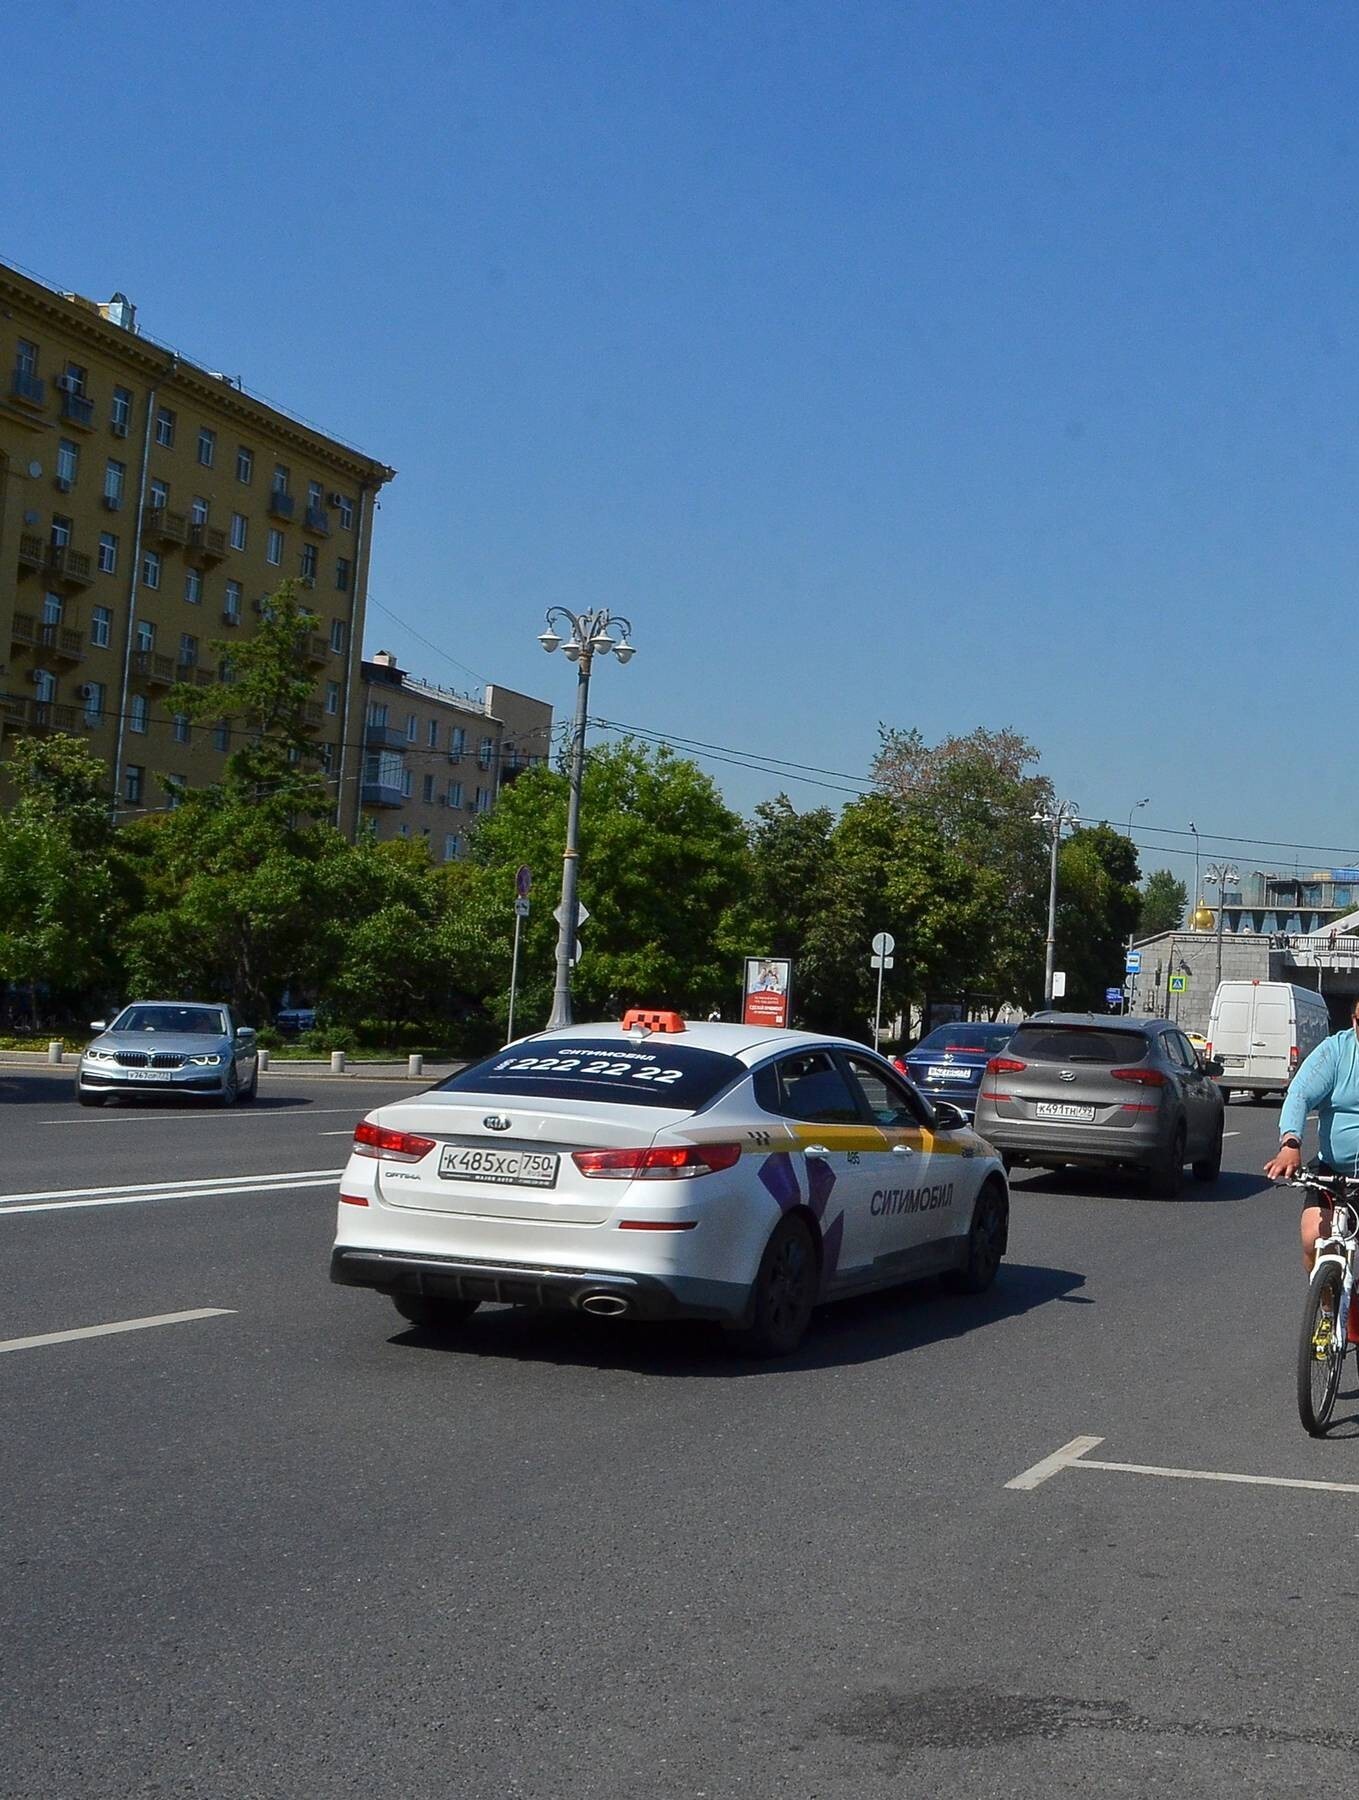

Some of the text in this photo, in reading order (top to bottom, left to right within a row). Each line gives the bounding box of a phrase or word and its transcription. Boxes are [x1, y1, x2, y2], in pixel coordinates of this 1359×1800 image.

[558, 1049, 656, 1061] СИТИМОБИЛ
[508, 1058, 581, 1071] 222
[580, 1061, 631, 1075] 22
[632, 1066, 683, 1084] 22
[486, 1117, 507, 1128] KIA
[446, 1151, 551, 1174] К485ХС 750
[870, 1183, 954, 1216] СИТИМОБИЛ
